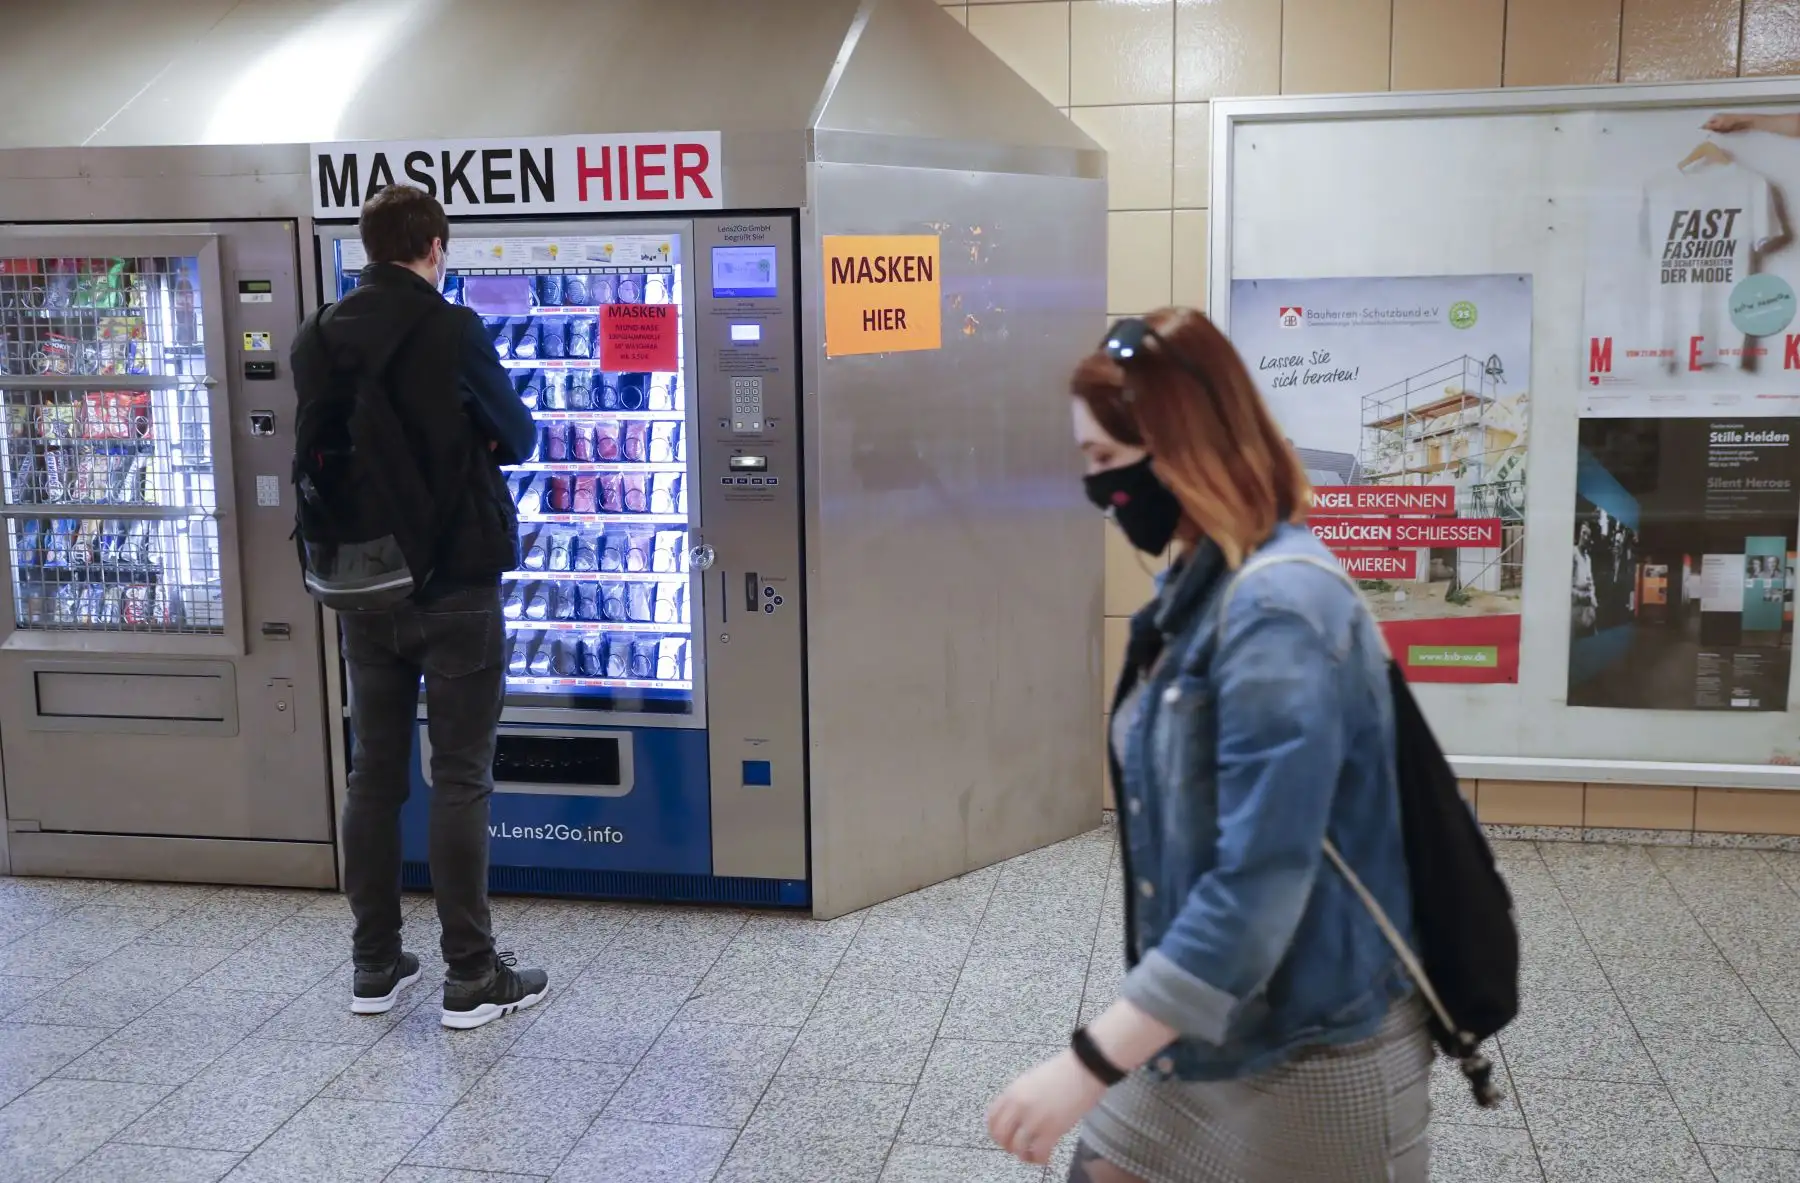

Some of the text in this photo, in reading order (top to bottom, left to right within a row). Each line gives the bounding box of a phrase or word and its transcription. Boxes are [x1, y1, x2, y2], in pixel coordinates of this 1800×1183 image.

[317, 143, 714, 208] MASKEN HIER
[748, 224, 772, 232] GmbH
[1667, 208, 1743, 241] FAST
[1662, 240, 1738, 260] FASHION
[830, 255, 934, 285] MASKEN
[1660, 267, 1734, 285] DER MODE
[608, 306, 667, 318] MASKEN
[862, 308, 907, 332] HIER
[1259, 348, 1332, 371] Lassen Sie
[1589, 334, 1800, 373] M E K
[1272, 366, 1360, 389] sich beraten!
[1709, 430, 1790, 443] Stille Helden
[1706, 477, 1792, 488] Silent Heroes
[1312, 492, 1447, 509] NGEL ERKENNEN
[1311, 522, 1492, 541] GSLÜCKEN SCHLIESSEN
[1337, 557, 1407, 573] IMIEREN
[488, 821, 624, 844] w.Lens2Go.info
